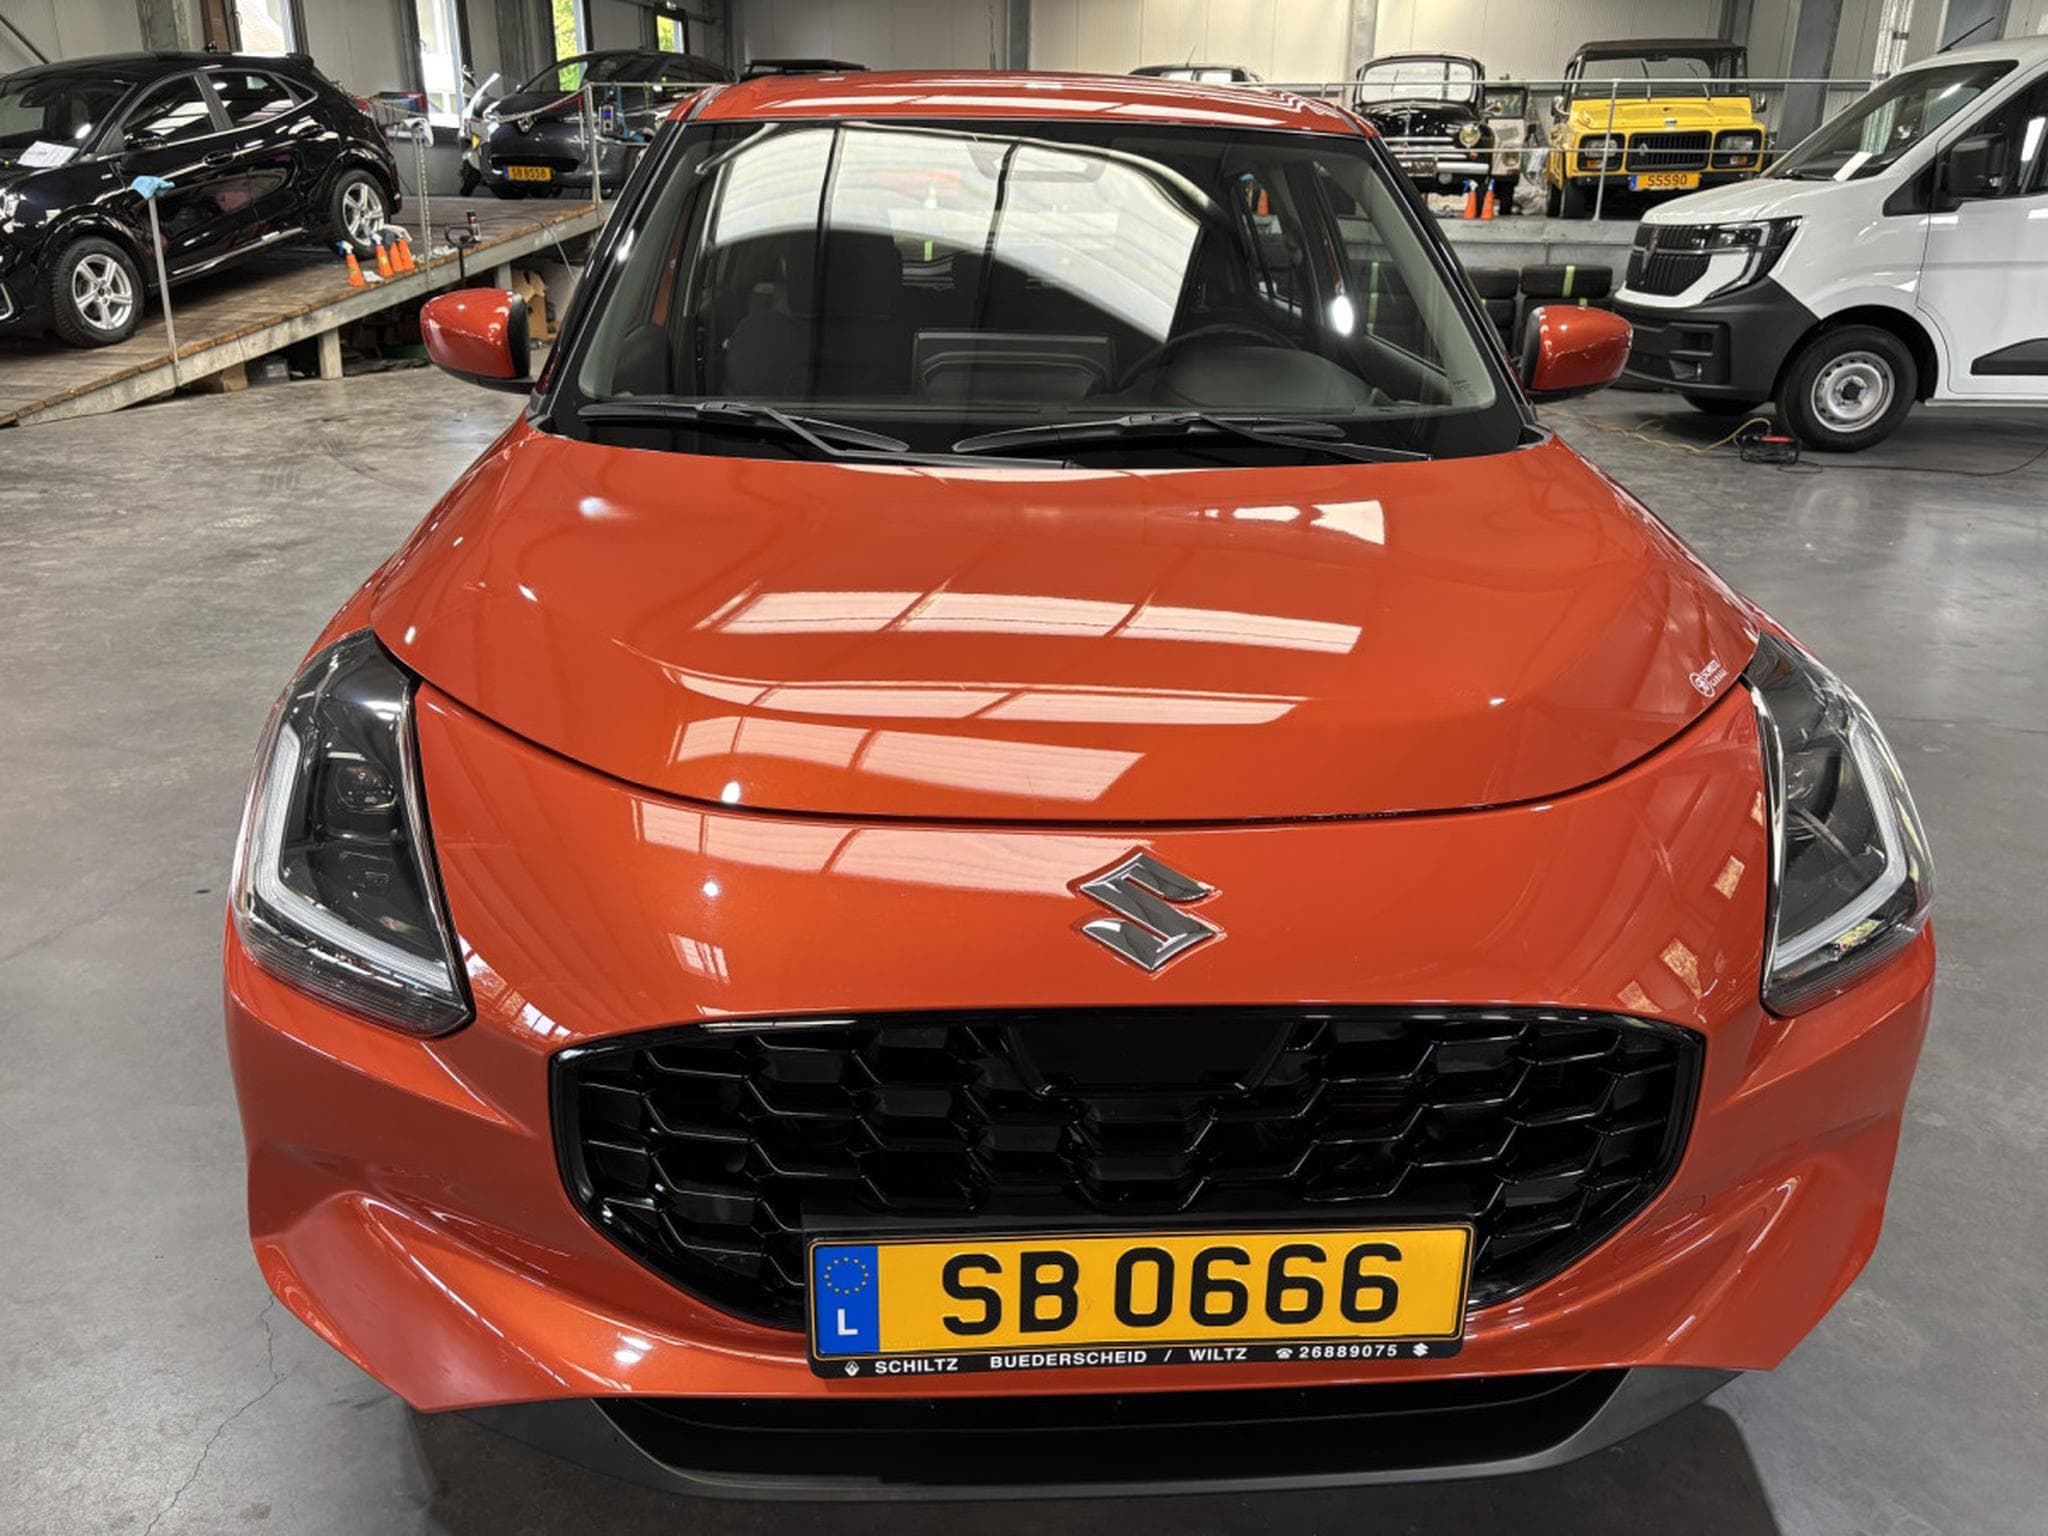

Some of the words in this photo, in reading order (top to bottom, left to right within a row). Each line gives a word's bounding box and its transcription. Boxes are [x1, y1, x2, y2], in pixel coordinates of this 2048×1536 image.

[942, 1250, 1080, 1336] SB
[1113, 1242, 1403, 1328] 0666
[837, 1308, 859, 1336] L
[874, 1357, 959, 1375] SCHILTZ
[989, 1350, 1148, 1370] BUEDERSCHEID
[1189, 1347, 1248, 1362] WILTZ
[1298, 1343, 1399, 1360] 26889075
